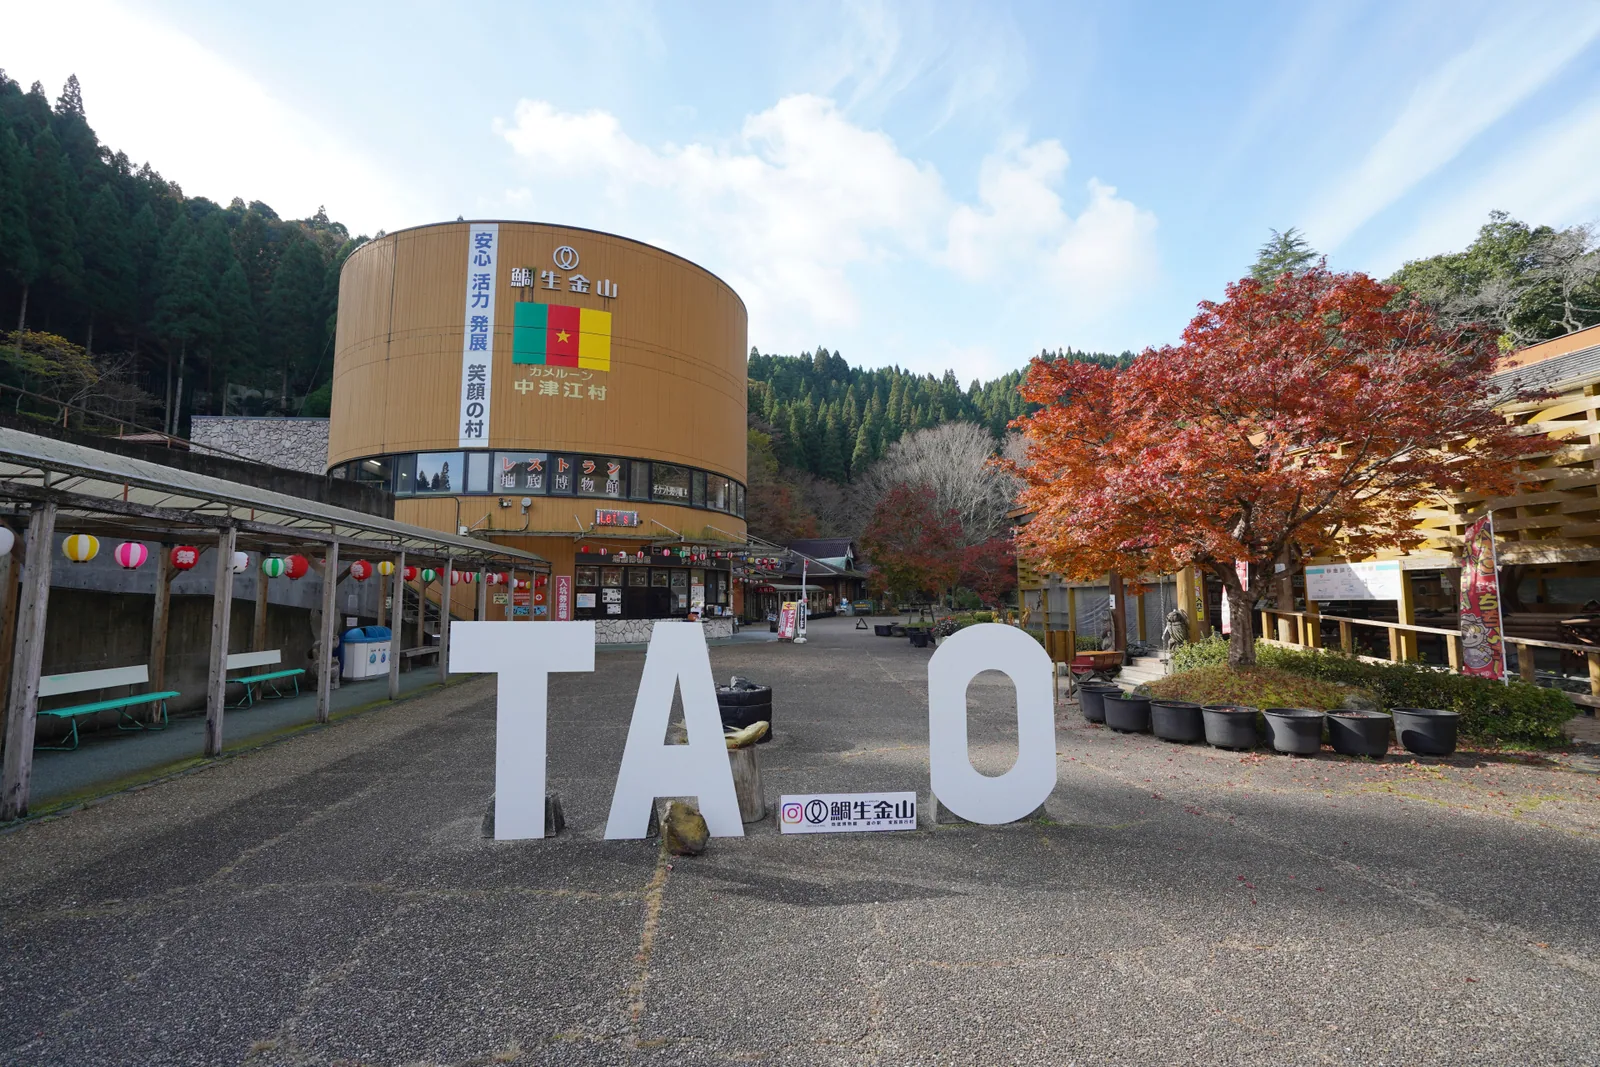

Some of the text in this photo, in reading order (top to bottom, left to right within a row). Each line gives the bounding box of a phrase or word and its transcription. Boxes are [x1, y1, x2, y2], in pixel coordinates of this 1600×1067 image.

[510, 267, 618, 299] 鯛生金山
[465, 232, 493, 438] 安心 活力 発展 笑顔の村
[529, 367, 593, 381] カメルーン
[514, 379, 607, 401] 中津江村
[503, 457, 620, 475] レストラン
[500, 473, 620, 495] 地底博物館
[830, 799, 915, 821] 鯛生金山
